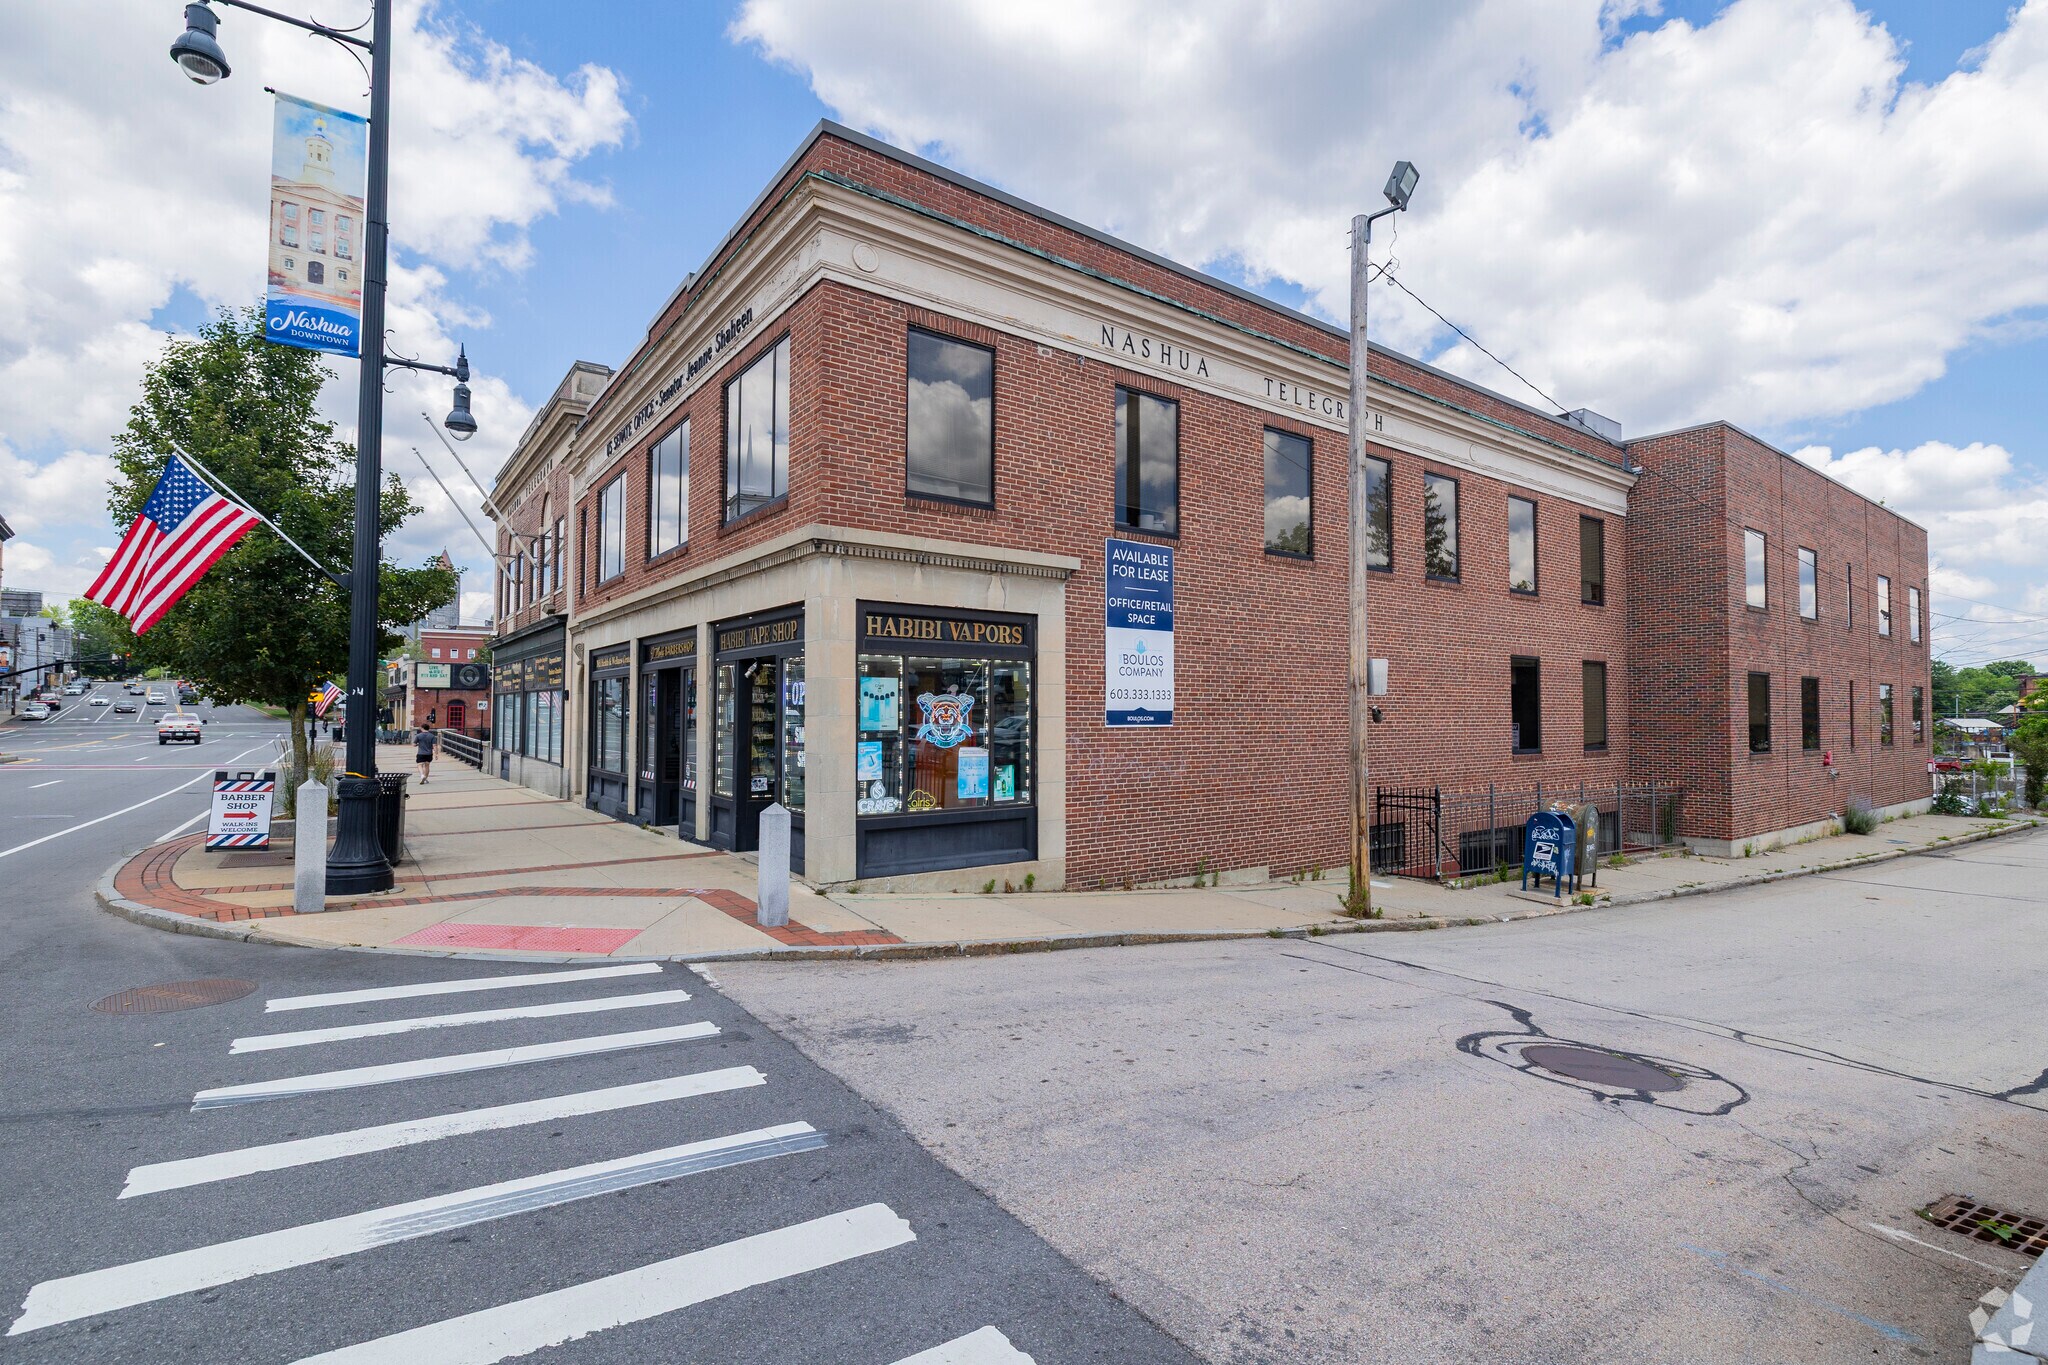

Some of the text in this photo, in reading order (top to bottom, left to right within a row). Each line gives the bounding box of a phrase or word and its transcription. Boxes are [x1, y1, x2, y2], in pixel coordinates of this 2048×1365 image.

[270, 310, 353, 337] Nashua
[291, 329, 349, 346] DOWNTOWN
[613, 421, 633, 450] SENATE
[633, 400, 655, 430] OFFICE
[658, 373, 684, 407] Senator
[685, 346, 713, 381] Jeanne
[714, 307, 753, 354] Shaheen
[1101, 324, 1383, 431] NASHUA TELEGRH
[1112, 548, 1169, 567] AVAILABLE
[1112, 564, 1169, 582] FOR LEASE
[1108, 597, 1173, 613] OFFICE/RETAIL
[1127, 613, 1156, 625] SPACE
[720, 620, 798, 650] HABIBI VAPE SHOP
[866, 615, 1024, 645] HABIBI VAPORS
[1122, 653, 1164, 667] BOULOS
[1119, 666, 1164, 677] COMPANY
[791, 681, 806, 706] OP
[1109, 688, 1172, 700] 603.333.1333
[226, 802, 258, 810] SHOP
